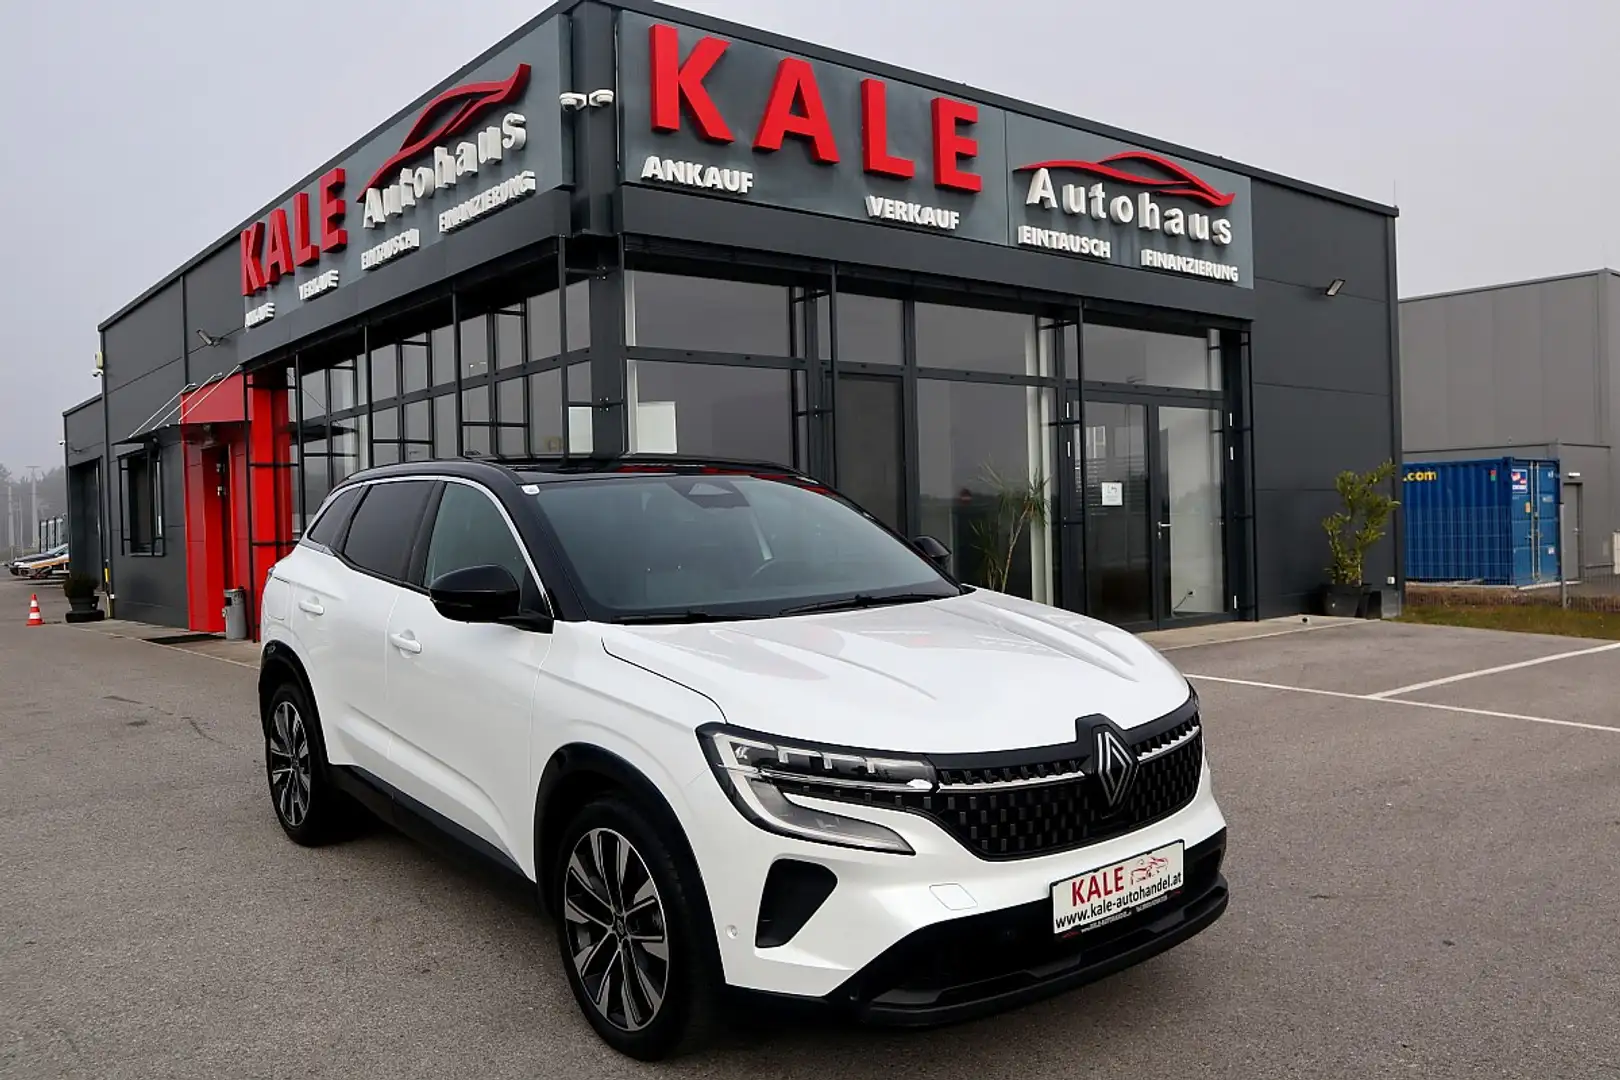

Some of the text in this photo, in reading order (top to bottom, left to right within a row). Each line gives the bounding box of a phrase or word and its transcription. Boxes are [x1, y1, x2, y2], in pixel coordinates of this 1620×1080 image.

[648, 23, 982, 193] KALE
[363, 112, 527, 229] Autohaus
[641, 155, 960, 230] ANKAUF VERKAUF
[1025, 167, 1233, 246] Autohaus
[240, 167, 347, 296] KALE
[1018, 225, 1239, 282] EINTAUSCH FINANZIERUNG
[1055, 872, 1182, 929] www.kale-autohandel.at
[1071, 866, 1125, 907] KALE
